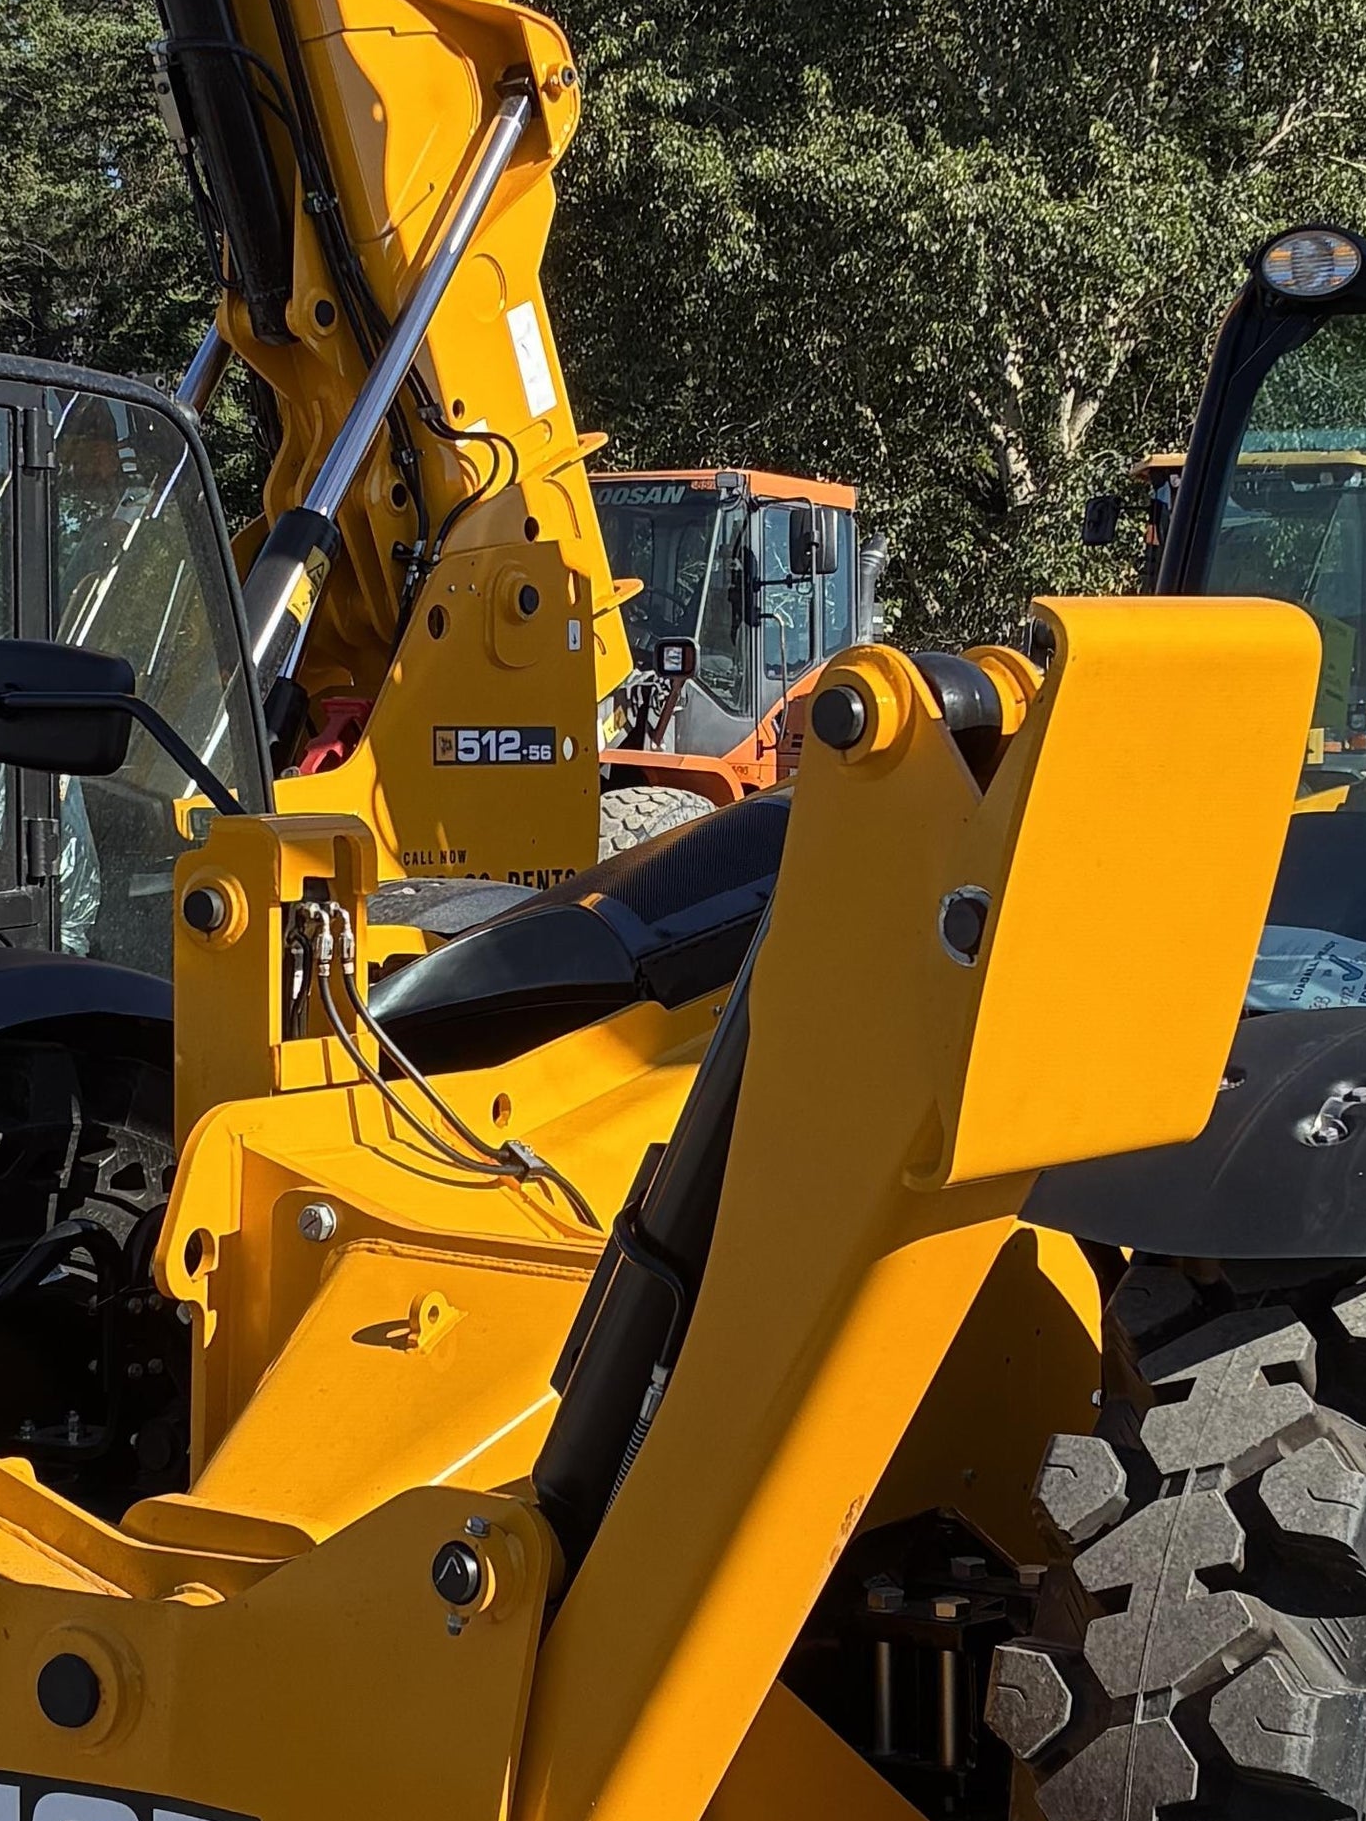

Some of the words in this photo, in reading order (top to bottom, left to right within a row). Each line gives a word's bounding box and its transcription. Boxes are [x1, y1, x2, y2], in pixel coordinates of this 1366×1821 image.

[595, 486, 686, 506] OOSAN
[402, 851, 434, 867] CALL
[439, 849, 467, 864] NOW
[1289, 961, 1320, 1002] LOADALL
